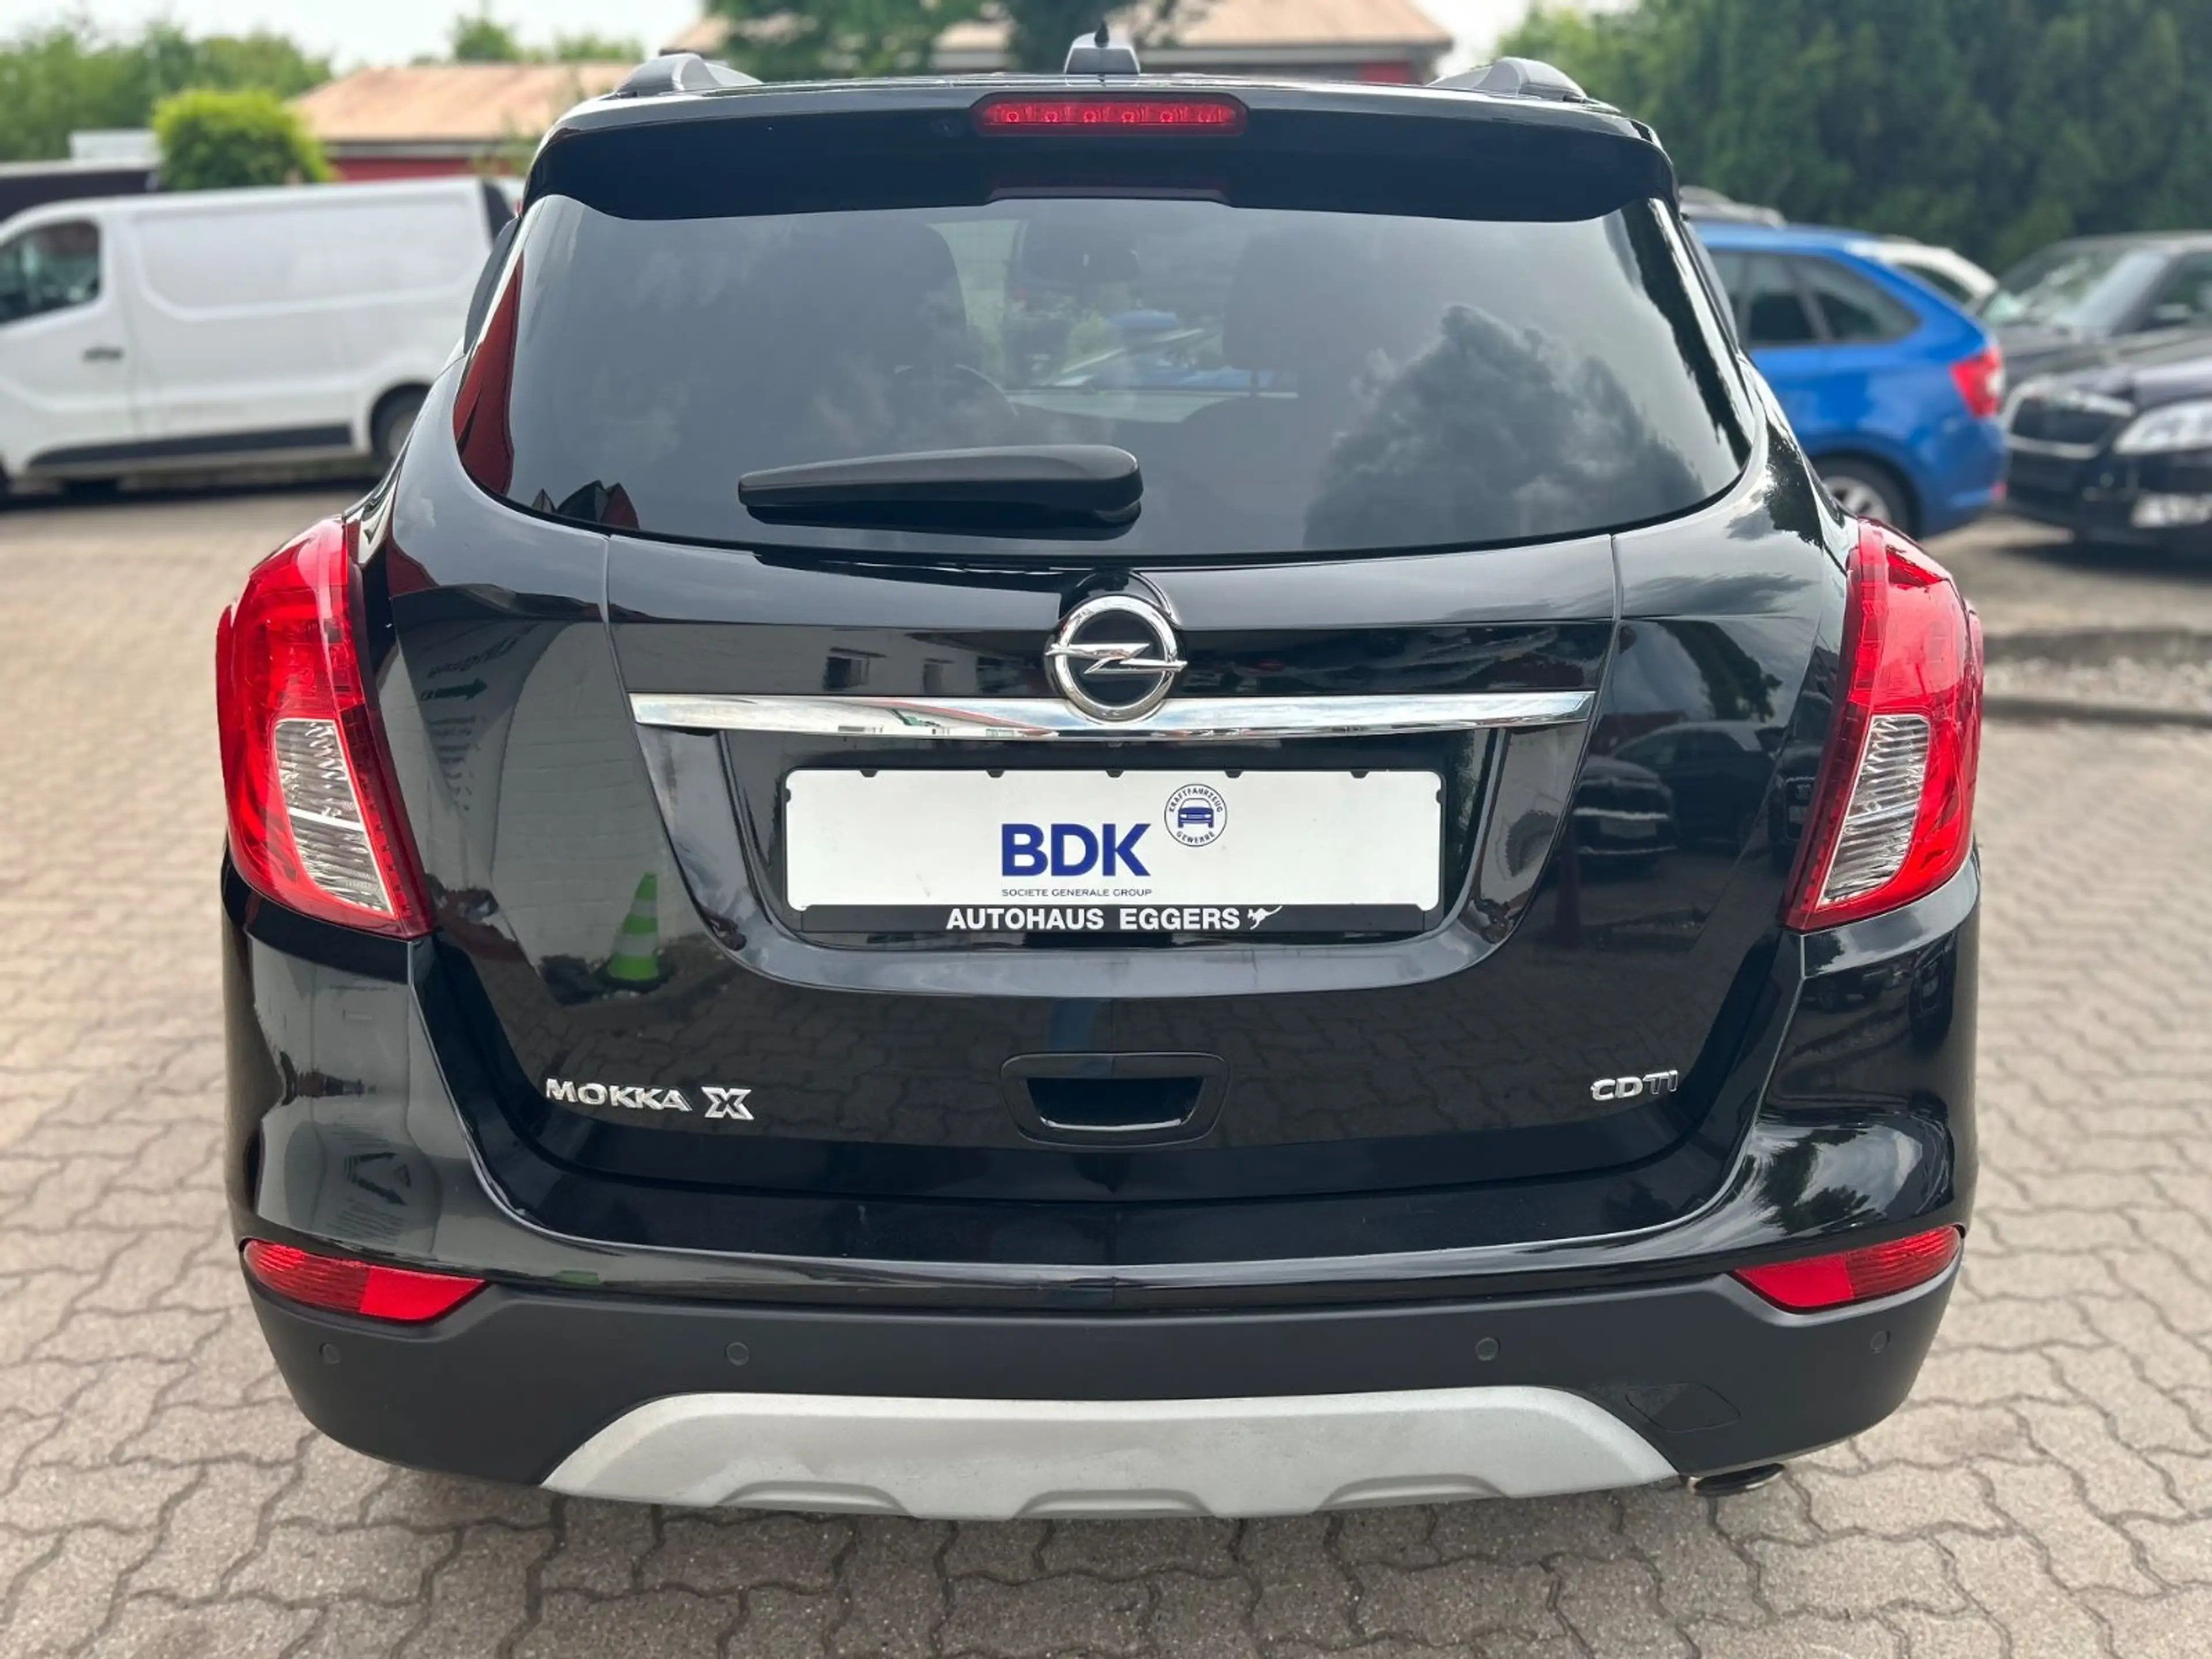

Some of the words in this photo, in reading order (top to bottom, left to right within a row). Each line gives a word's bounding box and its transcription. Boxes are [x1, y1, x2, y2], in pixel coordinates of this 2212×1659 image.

[1002, 823, 1151, 876] BDK
[1002, 889, 1048, 897] SOCIETE
[1051, 889, 1111, 897] GENERALE
[1112, 889, 1152, 897] GROUP
[946, 908, 1104, 930] AUTOHAUS
[1120, 908, 1240, 930] EGGERS
[545, 1078, 692, 1112] MOKKA
[700, 1086, 755, 1121] X
[1590, 1070, 1679, 1100] CDTI
